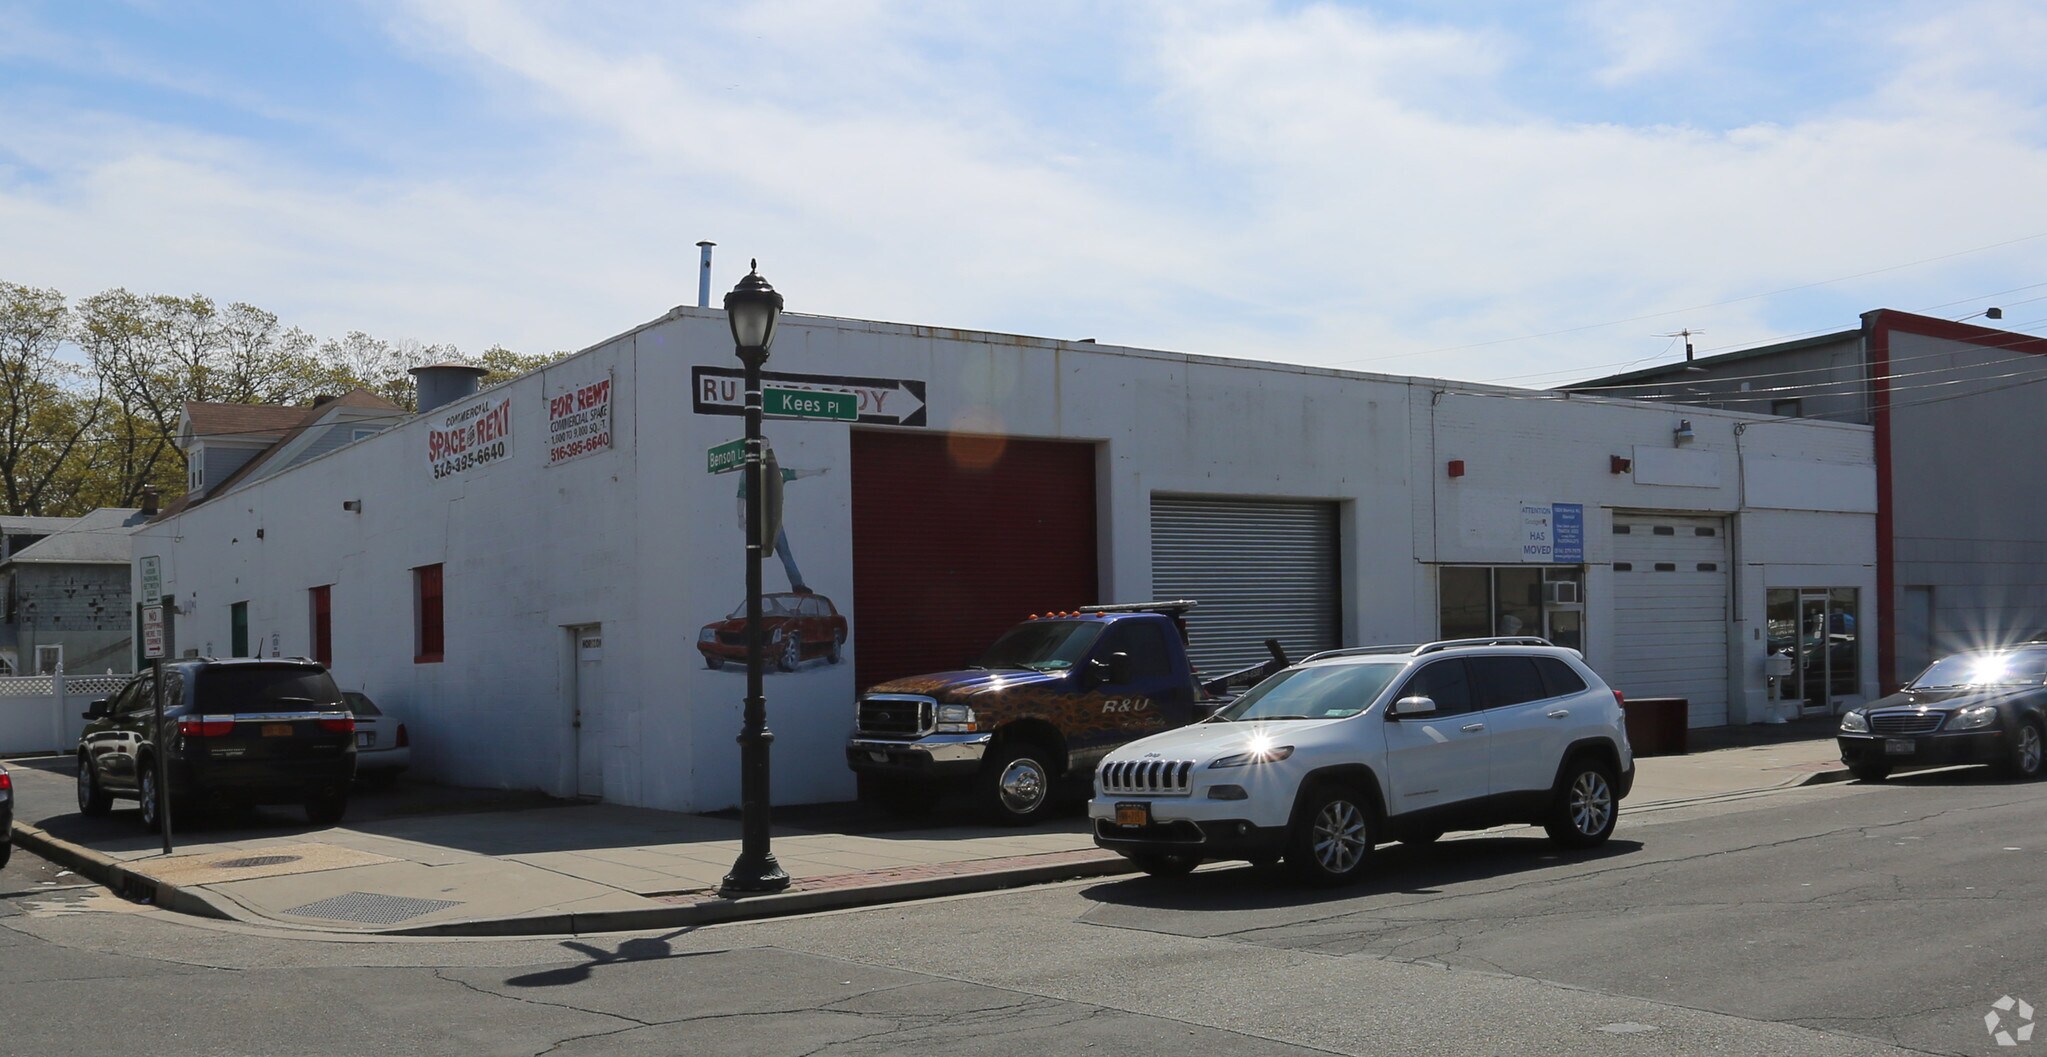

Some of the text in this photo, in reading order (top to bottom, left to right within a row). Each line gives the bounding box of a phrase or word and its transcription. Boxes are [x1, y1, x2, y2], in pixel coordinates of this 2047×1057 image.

[550, 380, 610, 421] FOR RENT
[782, 394, 821, 413] Kees
[827, 400, 839, 414] Pl
[446, 401, 490, 428] COMMERCIAL
[550, 403, 608, 433] COMMERCIAL SPACE
[429, 427, 466, 463] SPACE
[475, 397, 510, 446] RENT
[551, 431, 610, 462] 516-395-6640
[433, 441, 505, 480] 516-395-6640
[709, 449, 736, 468] Benson
[1522, 506, 1551, 514] ATTENTION
[1529, 531, 1545, 541] HAS
[1523, 545, 1551, 554] MOVED
[148, 611, 157, 622] NO
